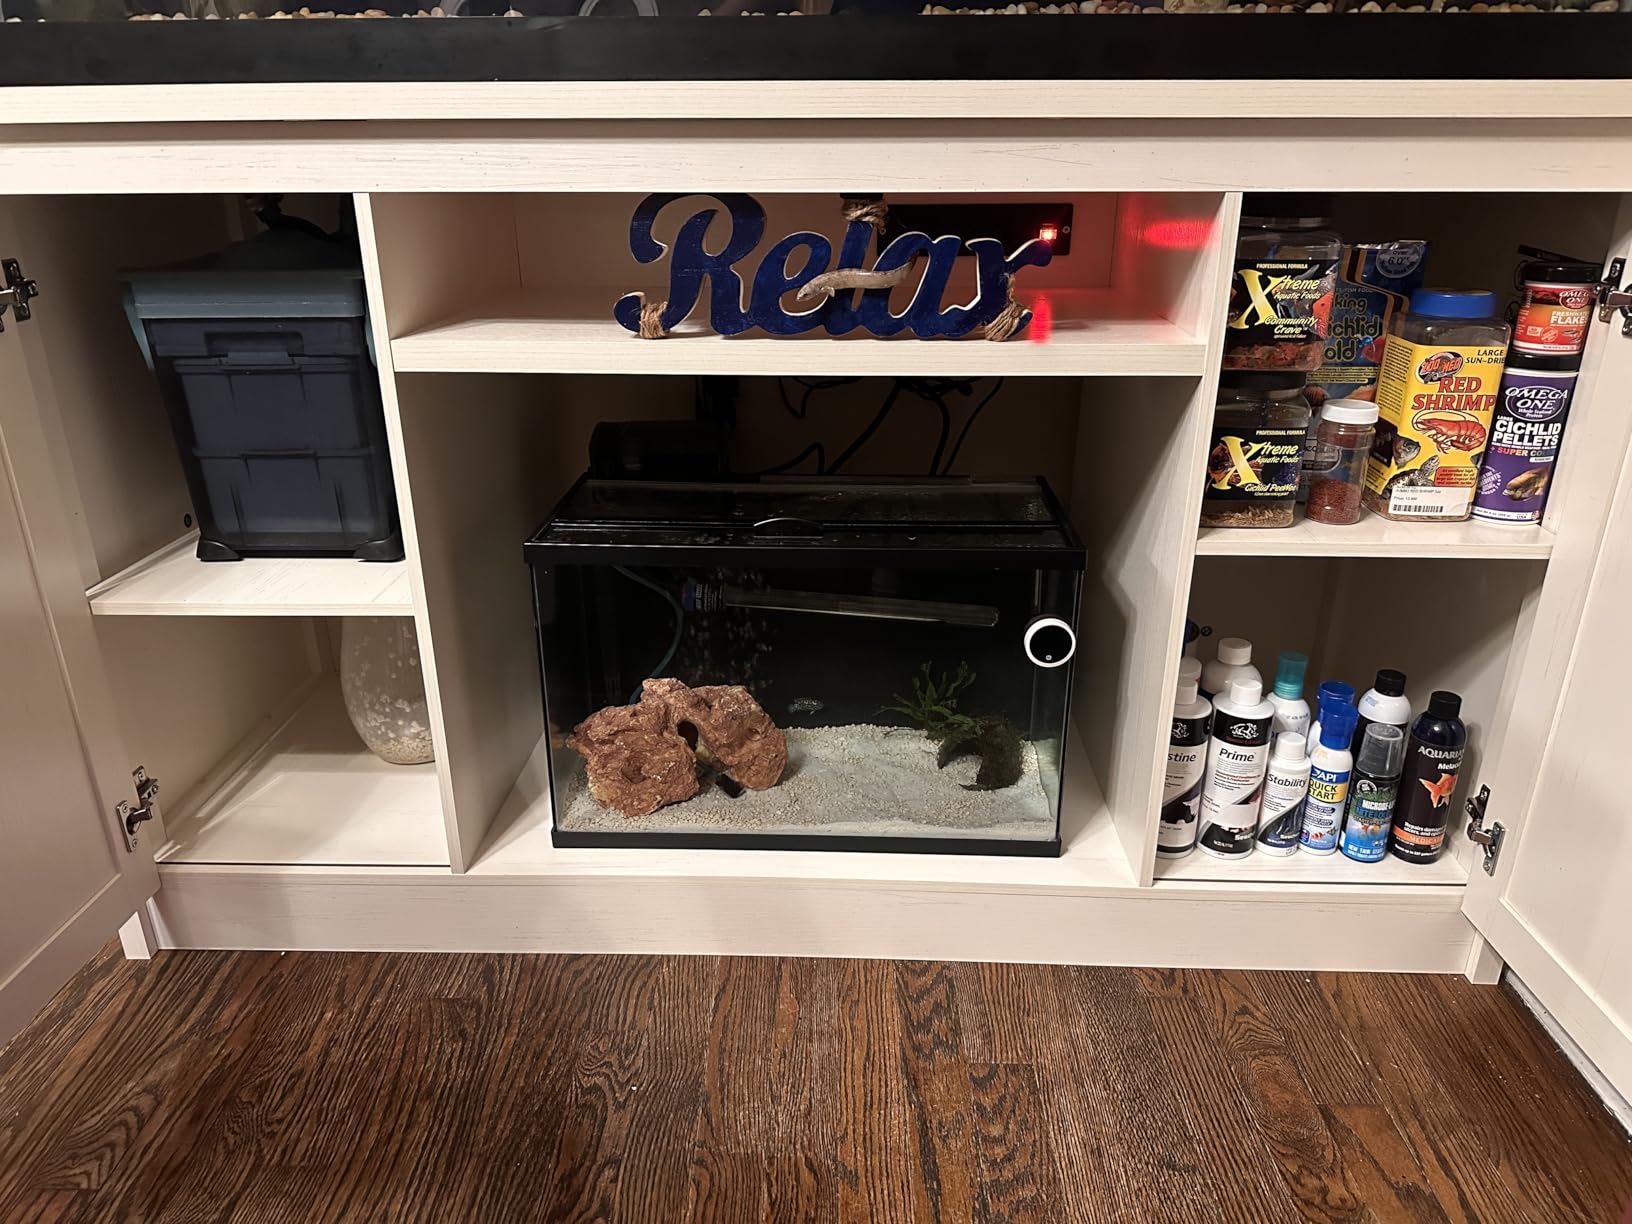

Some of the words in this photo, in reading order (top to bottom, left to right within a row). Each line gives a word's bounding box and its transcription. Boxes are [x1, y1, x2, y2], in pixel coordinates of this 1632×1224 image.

[613, 191, 1053, 341] Relax
[1229, 269, 1320, 329] Xtreme
[1273, 291, 1300, 300] Aquatic
[1300, 291, 1321, 299] Foods
[1333, 292, 1367, 314] king
[1264, 314, 1318, 327] Community
[1327, 314, 1380, 339] ichlid
[1273, 324, 1302, 334] Crave
[1323, 338, 1357, 361] old
[1420, 358, 1440, 373] ZOO
[1441, 356, 1463, 372] MED
[1465, 356, 1505, 364] SUN-DRIE
[1437, 376, 1482, 394] RED
[1505, 386, 1568, 400] OMEGA
[1411, 393, 1497, 412] SHRIMP
[1516, 398, 1556, 410] ONE
[1495, 419, 1562, 436] CICHLID
[1492, 431, 1559, 447] PELLETS
[1254, 456, 1280, 464] Aquatic
[1280, 455, 1299, 463] Foods
[1497, 447, 1528, 457] SUPER
[1211, 435, 1299, 490] Xtreme
[1244, 483, 1269, 492] Cichlid
[1167, 753, 1197, 762] stine
[1219, 747, 1255, 762] Prime
[1267, 773, 1306, 788] Stability
[1317, 771, 1337, 782] API
[1309, 778, 1338, 792] QUICK
